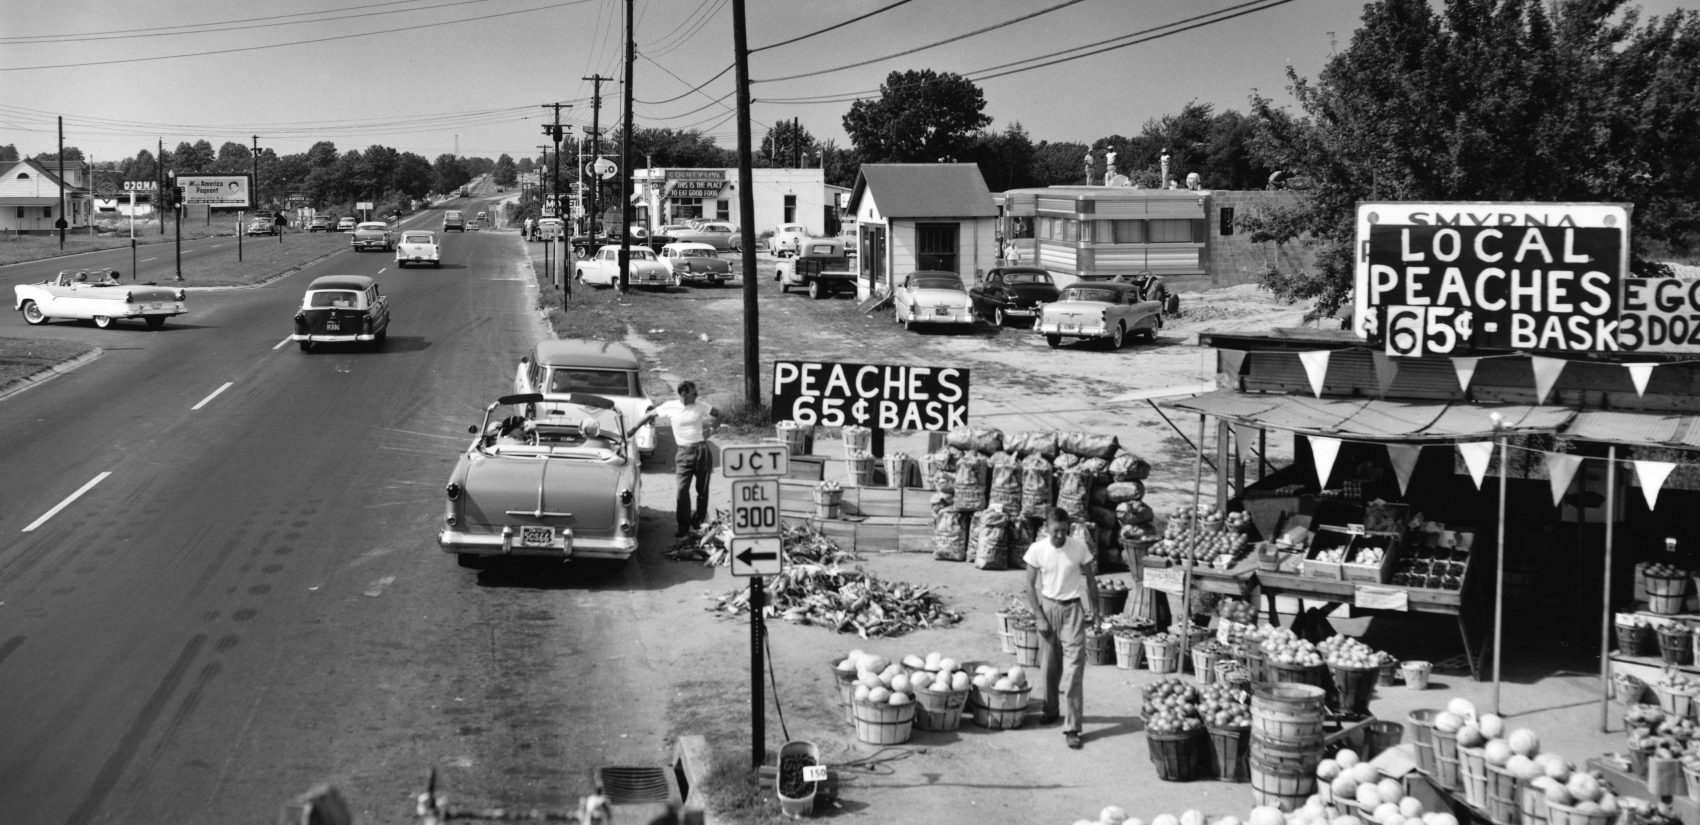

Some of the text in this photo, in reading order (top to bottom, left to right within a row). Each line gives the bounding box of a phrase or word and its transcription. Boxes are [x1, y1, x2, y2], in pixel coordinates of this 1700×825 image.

[677, 181, 688, 189] THIS
[1401, 228, 1590, 263] LOCAL
[1370, 264, 1611, 316] PEACHES
[1511, 313, 1619, 351] BASK
[774, 362, 963, 403] PEACHES
[792, 396, 966, 431] 65¢ BASK
[730, 451, 781, 471] JCT
[742, 485, 769, 501] DEL
[737, 506, 776, 528] 300
